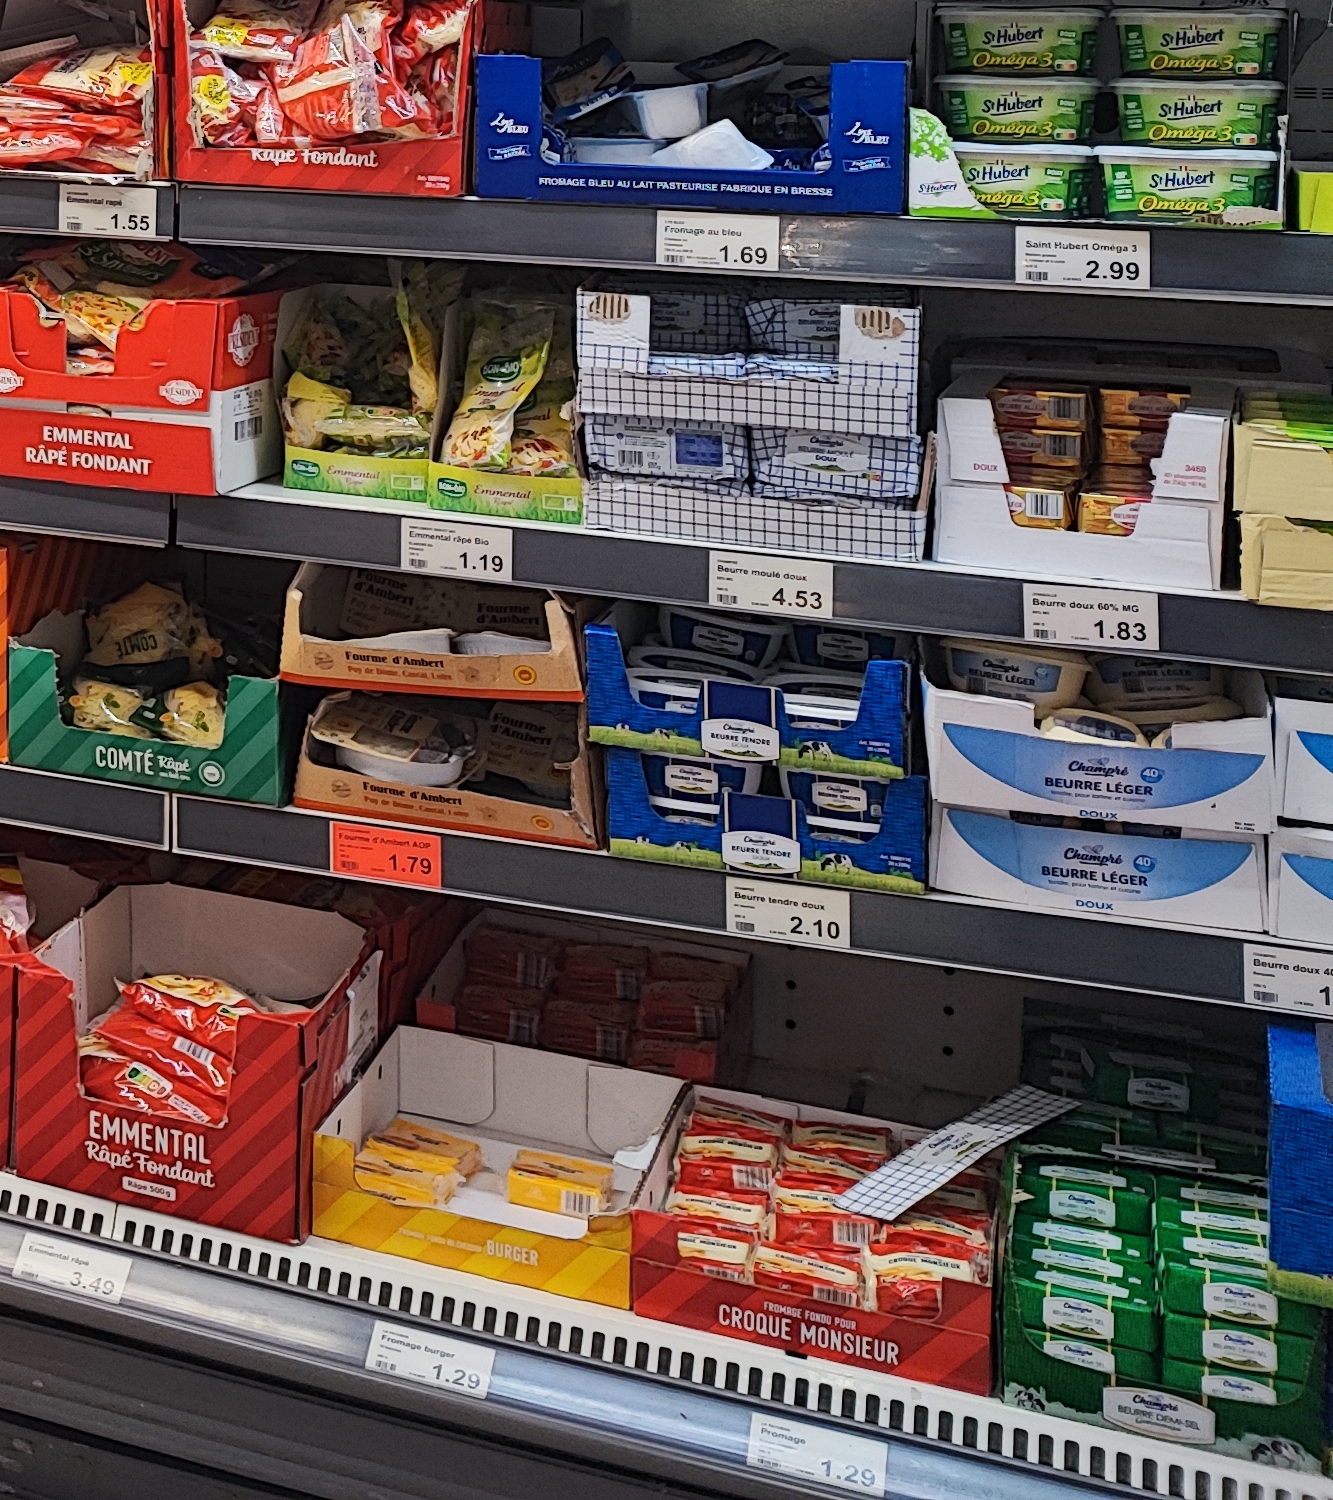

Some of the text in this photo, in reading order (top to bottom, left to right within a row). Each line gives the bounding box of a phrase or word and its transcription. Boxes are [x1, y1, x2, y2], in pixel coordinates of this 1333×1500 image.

[996, 27, 1044, 44] Hubert
[1175, 29, 1225, 46] Hubert
[972, 53, 1052, 70] Oméga 3
[1150, 55, 1233, 72] Oméga 3
[996, 96, 1044, 113] Hubert
[1174, 99, 1222, 117] Hubert
[972, 121, 1052, 139] Oméga 3
[1148, 126, 1231, 143] Oméga 3
[981, 165, 1031, 182] Hubert
[1164, 169, 1215, 187] Hubert
[1138, 196, 1225, 214] Oméga 3
[111, 215, 150, 232] 1.55
[719, 244, 768, 265] 1.69
[1086, 261, 1139, 281] 2.99
[43, 426, 133, 450] EMMENTAL
[26, 444, 152, 474] RÂPÉ FONDANT
[973, 463, 997, 472] DOUX
[459, 552, 504, 573] 1.19
[772, 588, 822, 610] 4.53
[1032, 597, 1139, 613] Beurre doux 60% MG
[1094, 620, 1147, 641] 1.83
[345, 652, 444, 668] Fourme d'Ambert
[96, 746, 192, 775] COMTÉ Râpé
[1068, 761, 1129, 778] Champré
[1142, 769, 1158, 778] 40
[363, 782, 461, 805] Fourme d'Ambert
[1045, 777, 1103, 791] BEURRE
[1108, 779, 1153, 797] LÉGER
[1079, 809, 1118, 821] DOUX
[388, 855, 431, 875] 1.79
[1064, 848, 1123, 865] Champré
[1136, 857, 1151, 867] 40
[1041, 866, 1148, 887] BEURRE LÉGER
[734, 892, 825, 910] Beurre tendre doux
[1076, 900, 1114, 911] DOUX
[790, 917, 840, 940] 2.10
[1253, 958, 1285, 970] Beurre
[89, 1111, 209, 1163] EMMENTAL
[85, 1140, 215, 1188] Râpé Fondant
[487, 1240, 539, 1266] BURGER
[70, 1271, 115, 1296] 3.49
[764, 1301, 857, 1329] FROMAGE FONDU POUR
[719, 1305, 899, 1366] CROQUE MONSIEUR
[381, 1334, 455, 1361] Fromage burger
[432, 1364, 480, 1390] 1.29
[821, 1459, 875, 1488] 1.29
